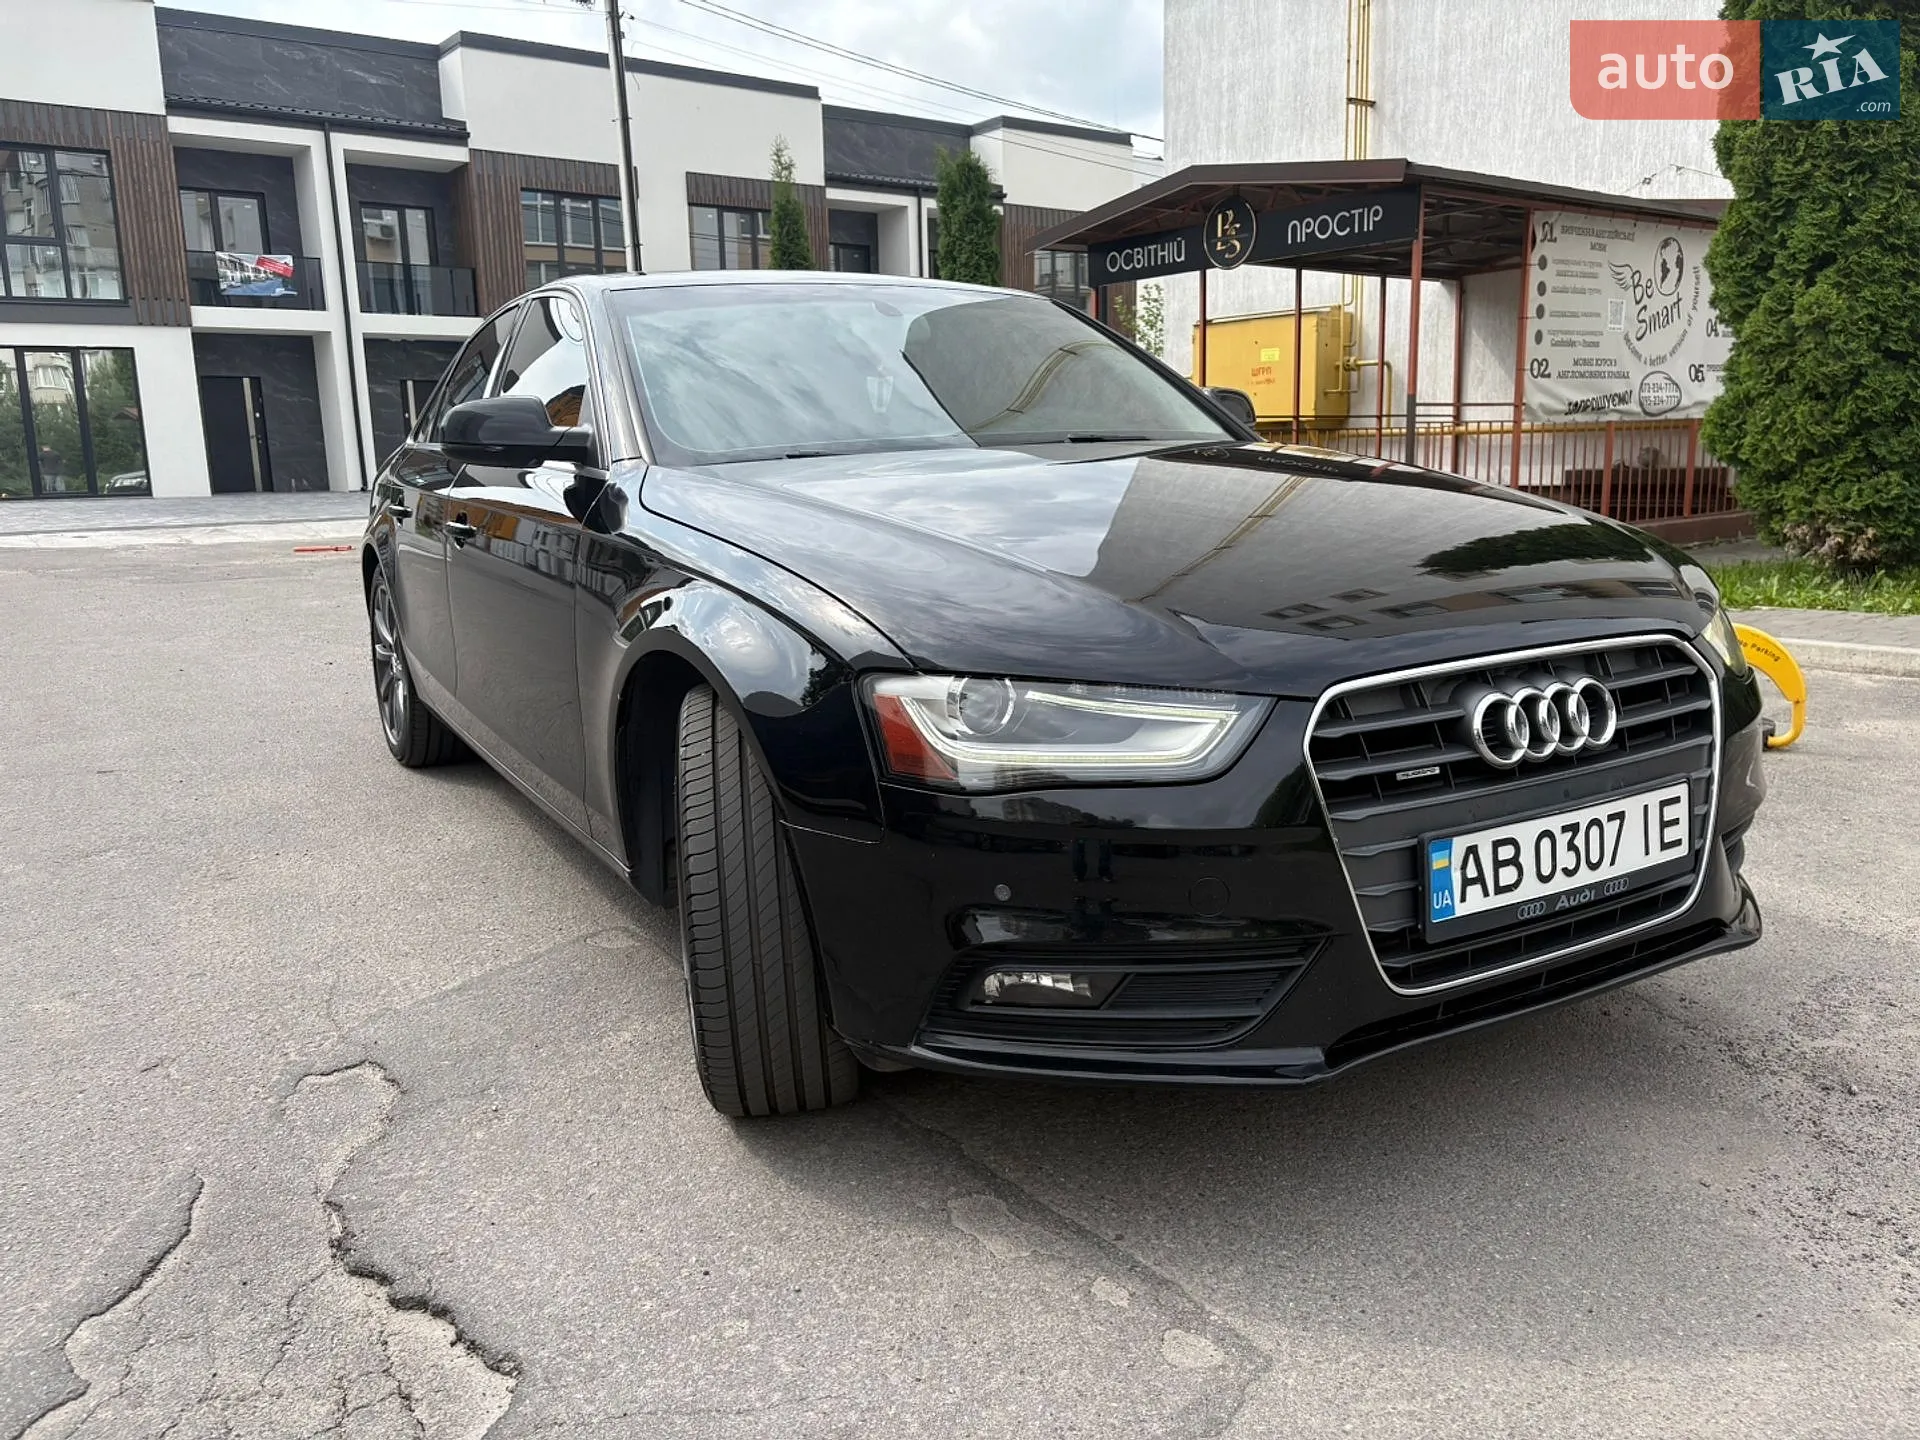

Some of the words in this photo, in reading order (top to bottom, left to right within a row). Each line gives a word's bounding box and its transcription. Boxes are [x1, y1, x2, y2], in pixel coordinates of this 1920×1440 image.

[1287, 205, 1384, 245] ПРОСТІР
[1106, 237, 1186, 273] ОСВІТНІЙ
[1631, 270, 1654, 305] Be
[1635, 292, 1682, 341] Smart
[1530, 358, 1551, 378] 02
[1689, 364, 1705, 383] 05
[1750, 643, 1781, 662] Parking
[1460, 837, 1524, 903] AB
[1535, 810, 1626, 884] 0307
[1643, 796, 1682, 856] IE
[1433, 893, 1451, 910] UA
[1555, 889, 1595, 910] Audi
